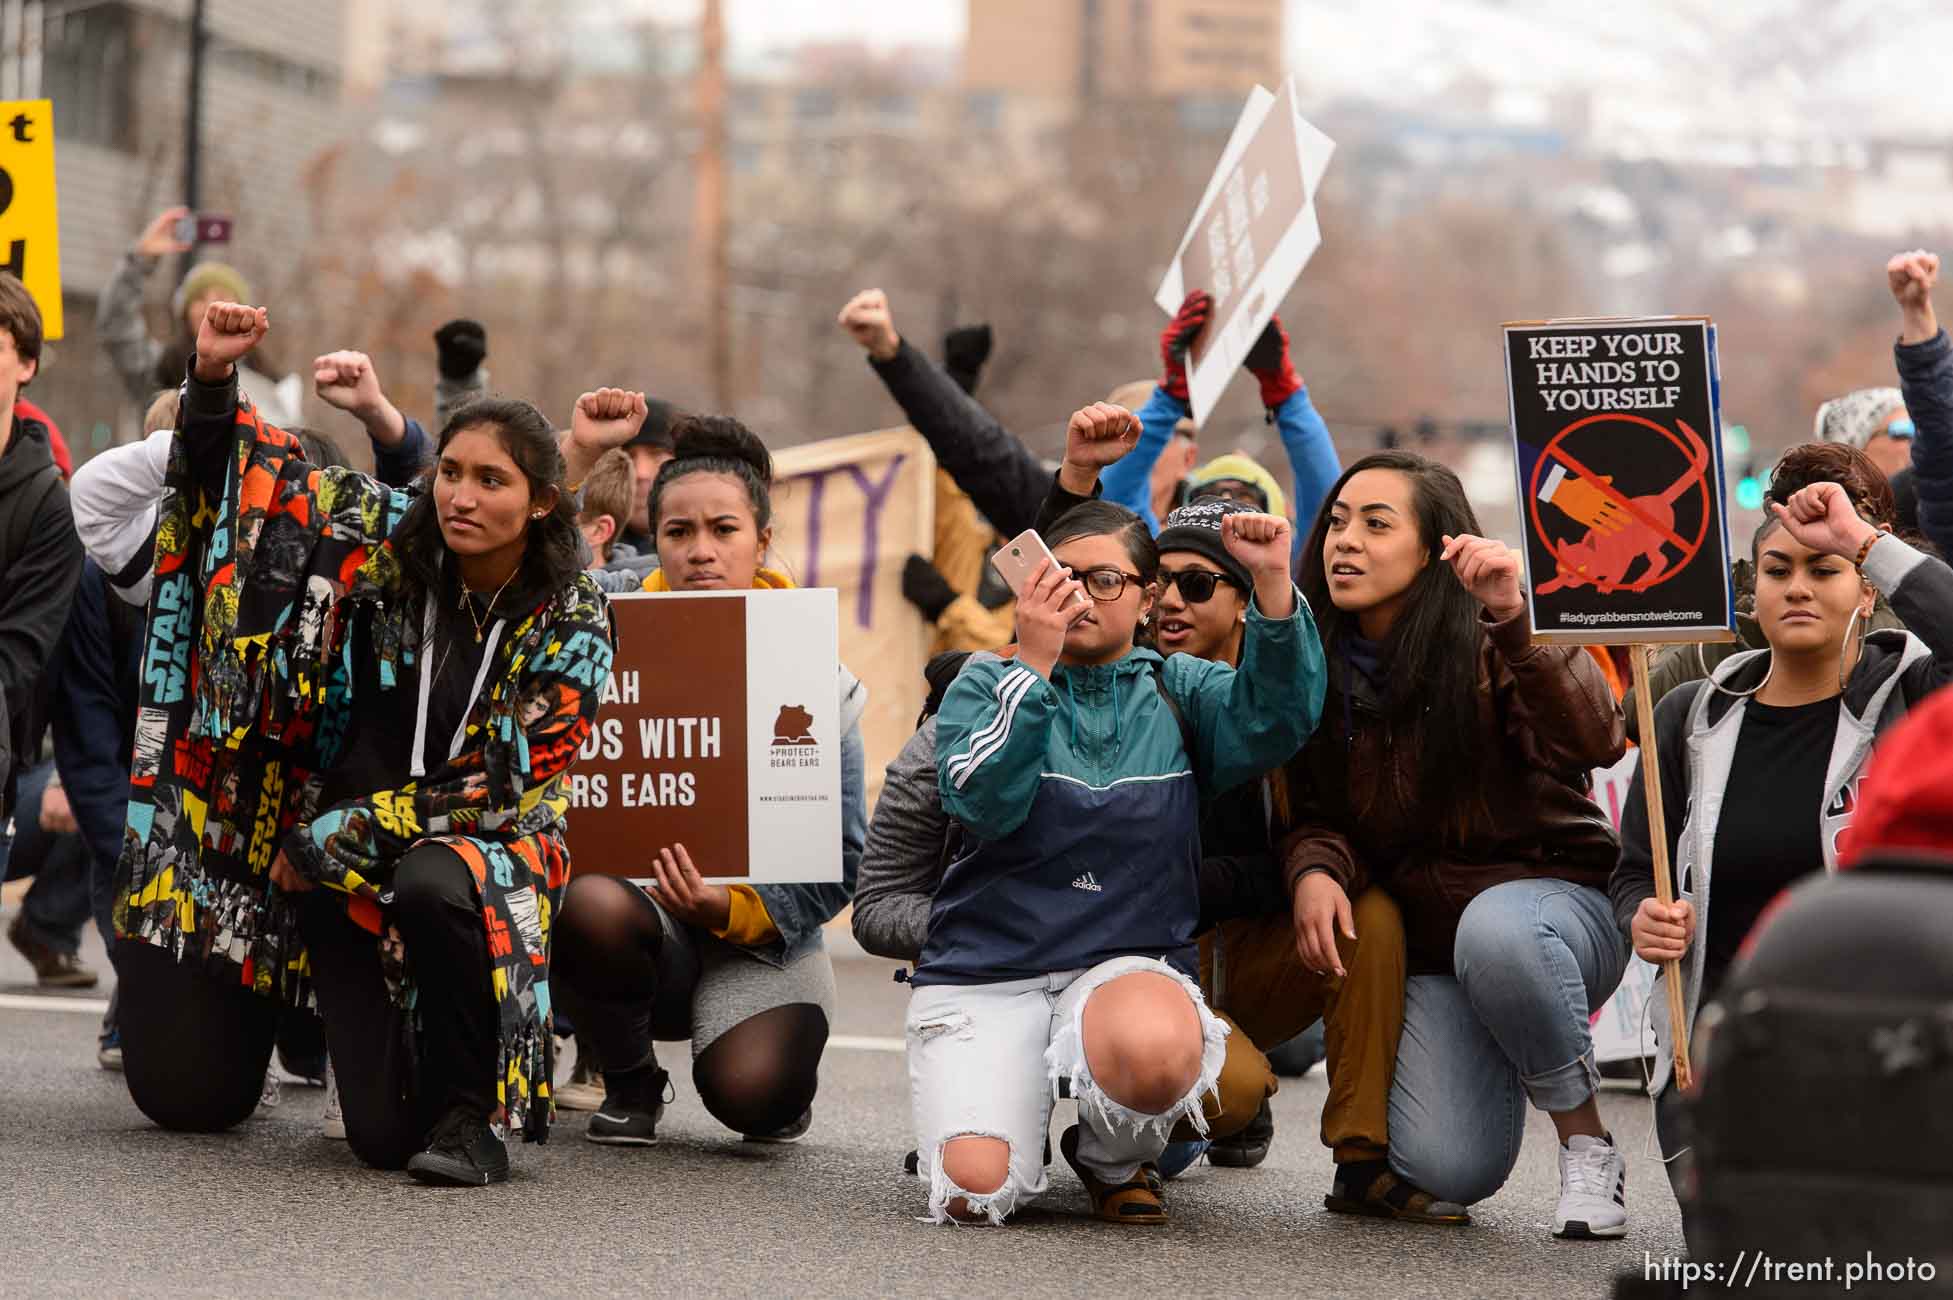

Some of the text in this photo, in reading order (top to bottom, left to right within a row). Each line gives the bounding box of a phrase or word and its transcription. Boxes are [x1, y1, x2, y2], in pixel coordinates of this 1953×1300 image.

[1528, 333, 1684, 359] KEEP YOUR
[1536, 359, 1681, 385] HANDS TO
[1540, 386, 1681, 411] YOURSELF
[1560, 610, 1704, 625] #ladygrabbersnotwelcome
[638, 717, 721, 759] WITH
[770, 758, 820, 768] BEARS EARS
[775, 747, 815, 757] PROTECT
[622, 771, 696, 807] EARS
[1072, 881, 1102, 891] adidas
